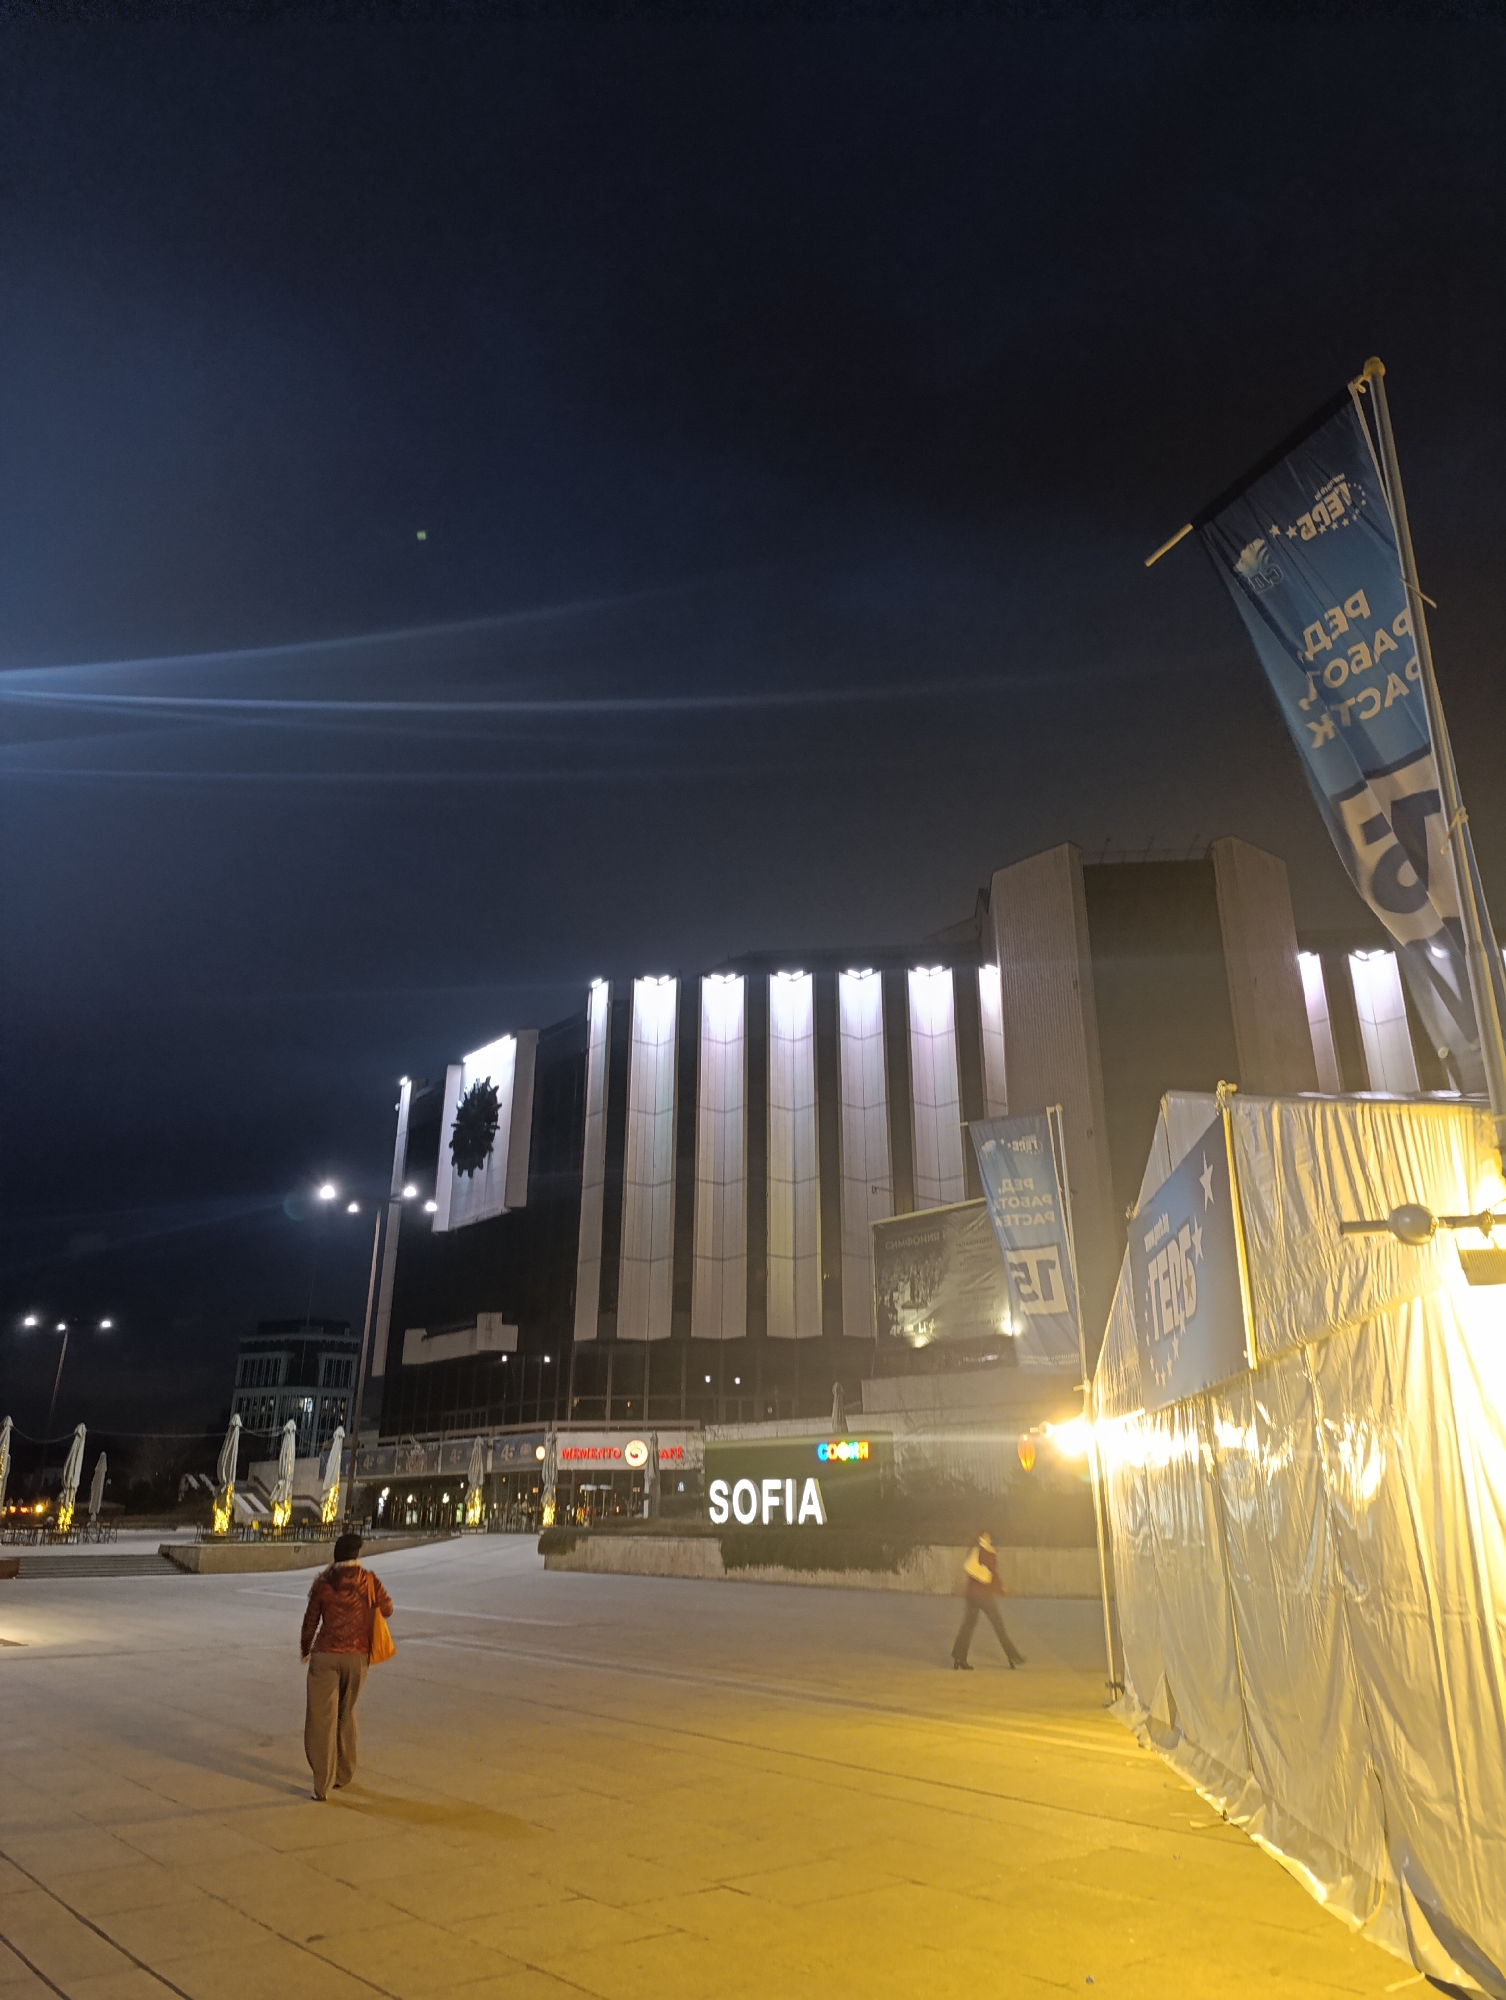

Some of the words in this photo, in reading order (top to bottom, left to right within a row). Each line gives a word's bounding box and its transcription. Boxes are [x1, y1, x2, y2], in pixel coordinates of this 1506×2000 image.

[1148, 1223, 1197, 1342] ГЕРБ
[561, 1446, 622, 1460] MEMENTO
[658, 1445, 683, 1460] AFÉ
[816, 1440, 870, 1463] СОФИЯ
[708, 1477, 827, 1526] SOFIA
